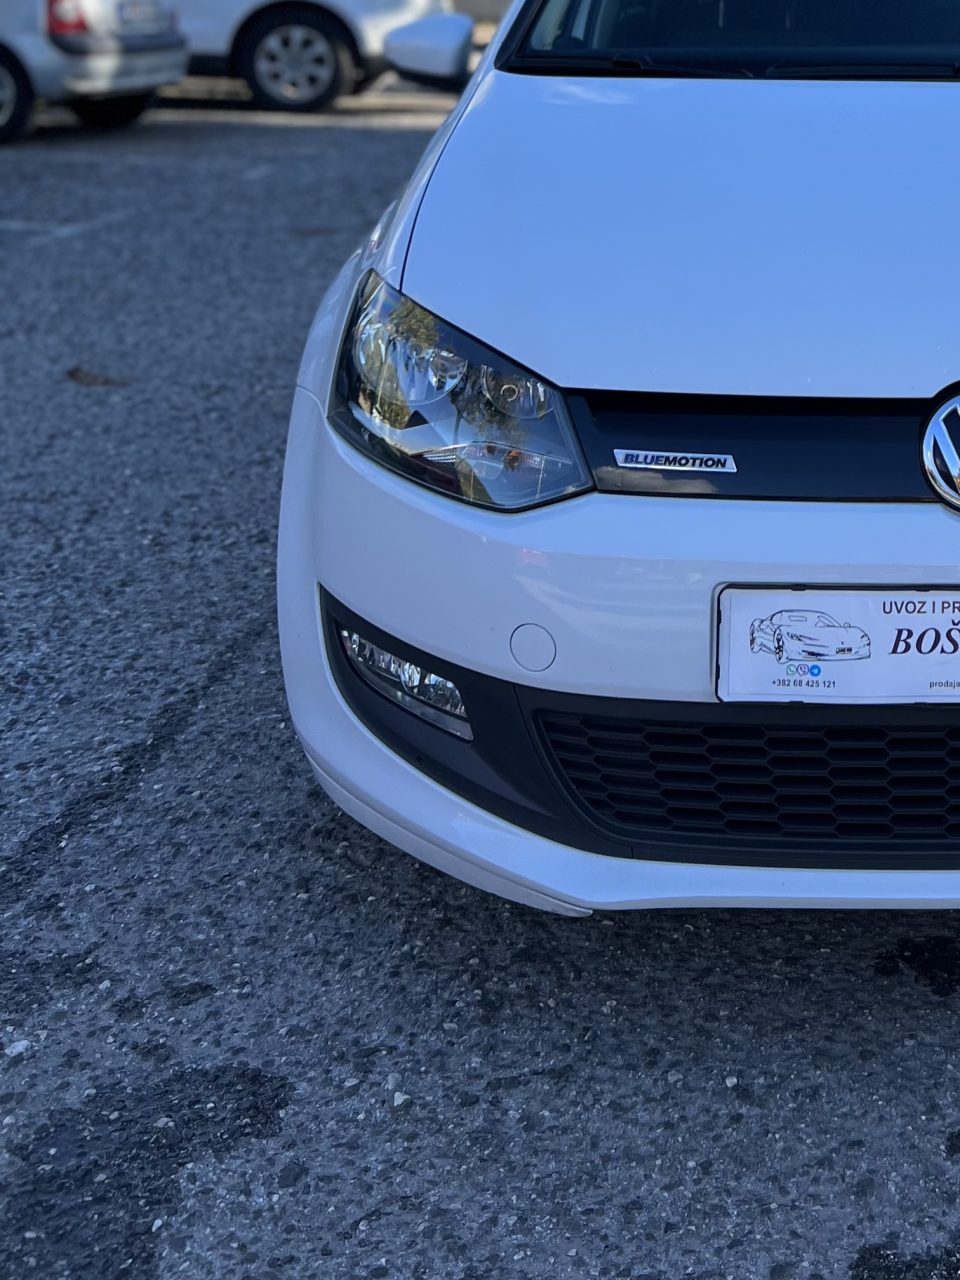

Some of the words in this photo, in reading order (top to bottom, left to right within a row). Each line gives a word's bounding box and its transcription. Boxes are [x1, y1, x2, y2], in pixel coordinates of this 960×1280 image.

[623, 453, 727, 468] BLUEMOTION
[882, 600, 927, 614] UVOZ
[931, 600, 936, 614] I
[772, 679, 791, 688] +382
[793, 679, 803, 688] 68
[805, 680, 820, 688] 425
[823, 680, 836, 688] 121
